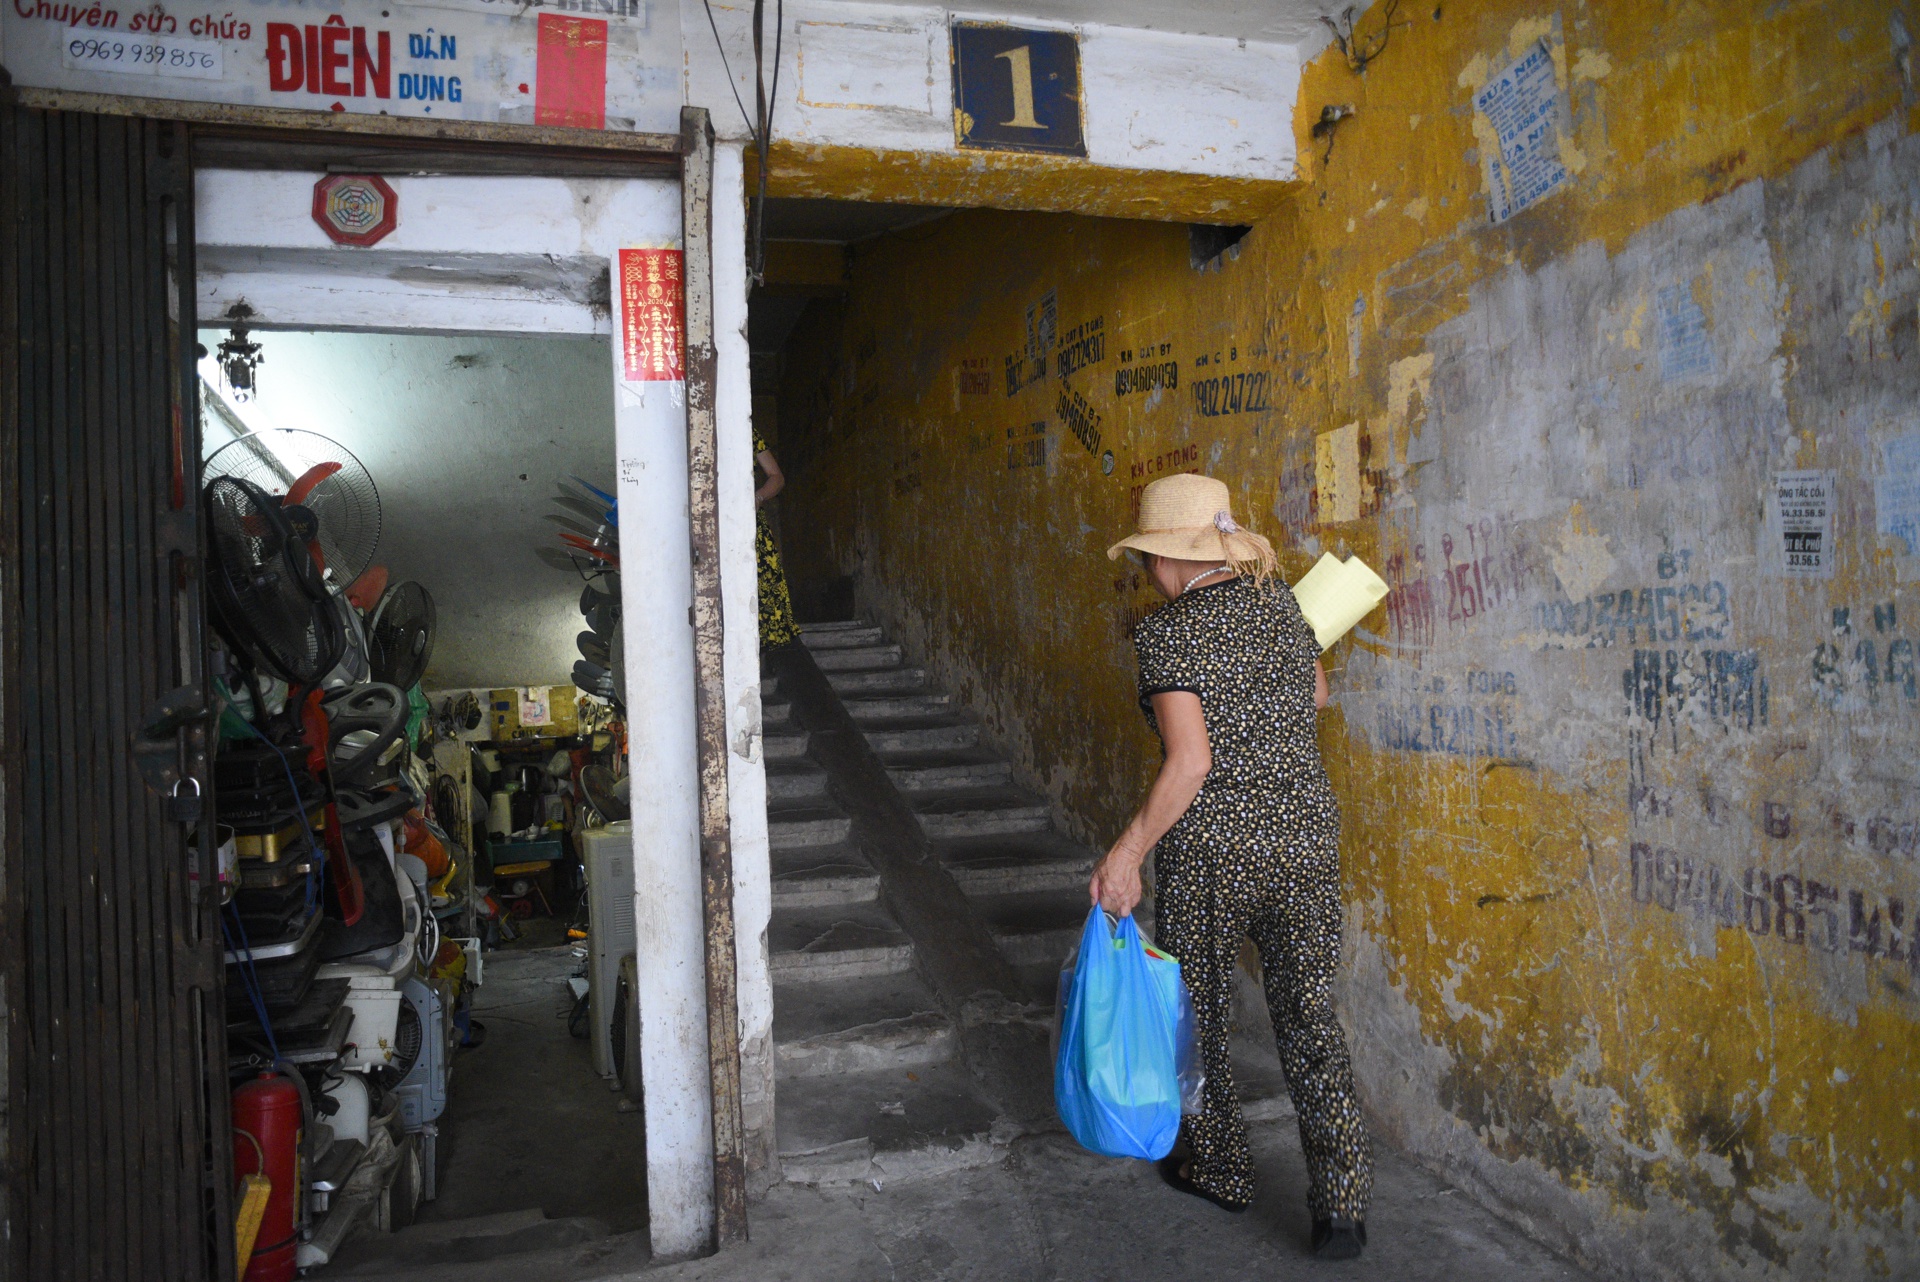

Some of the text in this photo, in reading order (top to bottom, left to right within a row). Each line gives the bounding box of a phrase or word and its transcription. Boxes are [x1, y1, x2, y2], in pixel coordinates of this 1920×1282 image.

[189, 12, 251, 40] chữa
[69, 39, 215, 69] 0969.939.856
[994, 45, 1049, 129] 1
[1231, 347, 1237, 361] B
[1166, 444, 1198, 468] TONG
